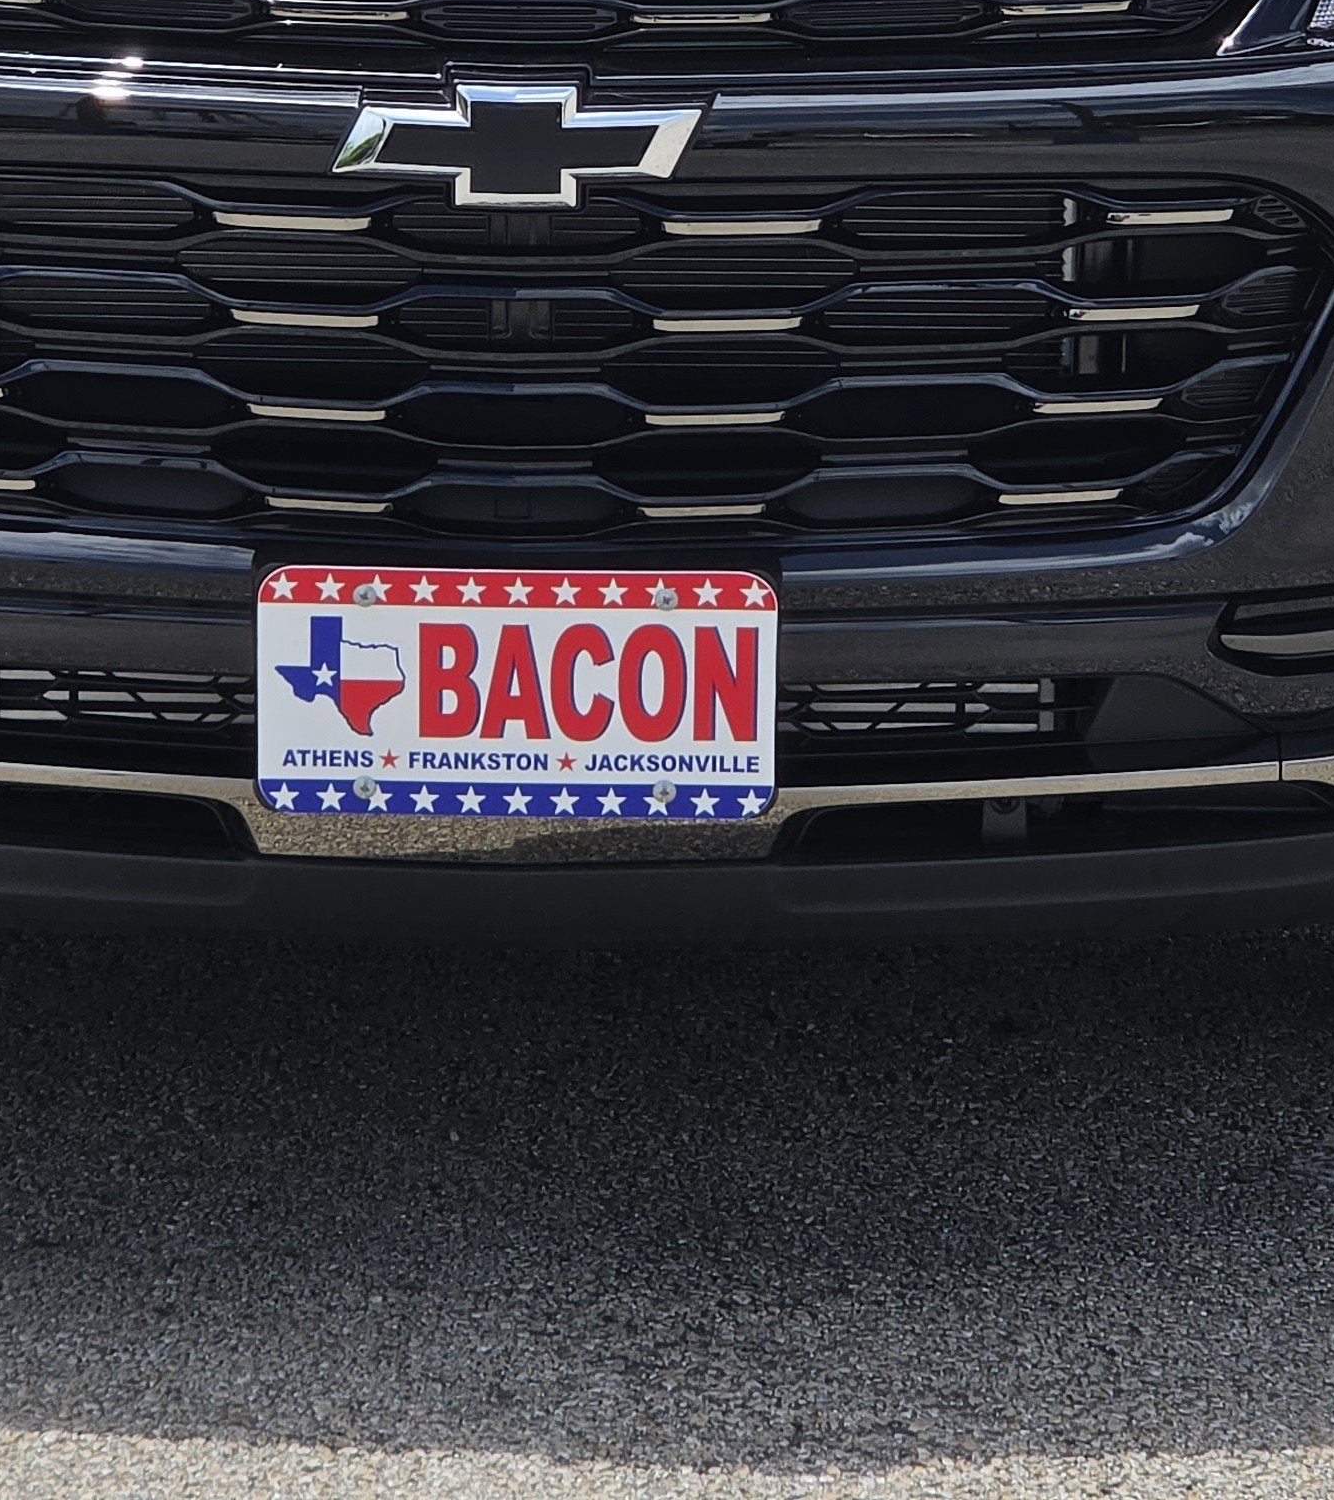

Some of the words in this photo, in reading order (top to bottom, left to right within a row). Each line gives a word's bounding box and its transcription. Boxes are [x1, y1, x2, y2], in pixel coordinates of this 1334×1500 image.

[418, 621, 760, 743] BACON
[282, 748, 374, 769] ATHENS
[408, 751, 549, 772] FRANKSTON
[584, 754, 760, 774] JACKSONVILLE
